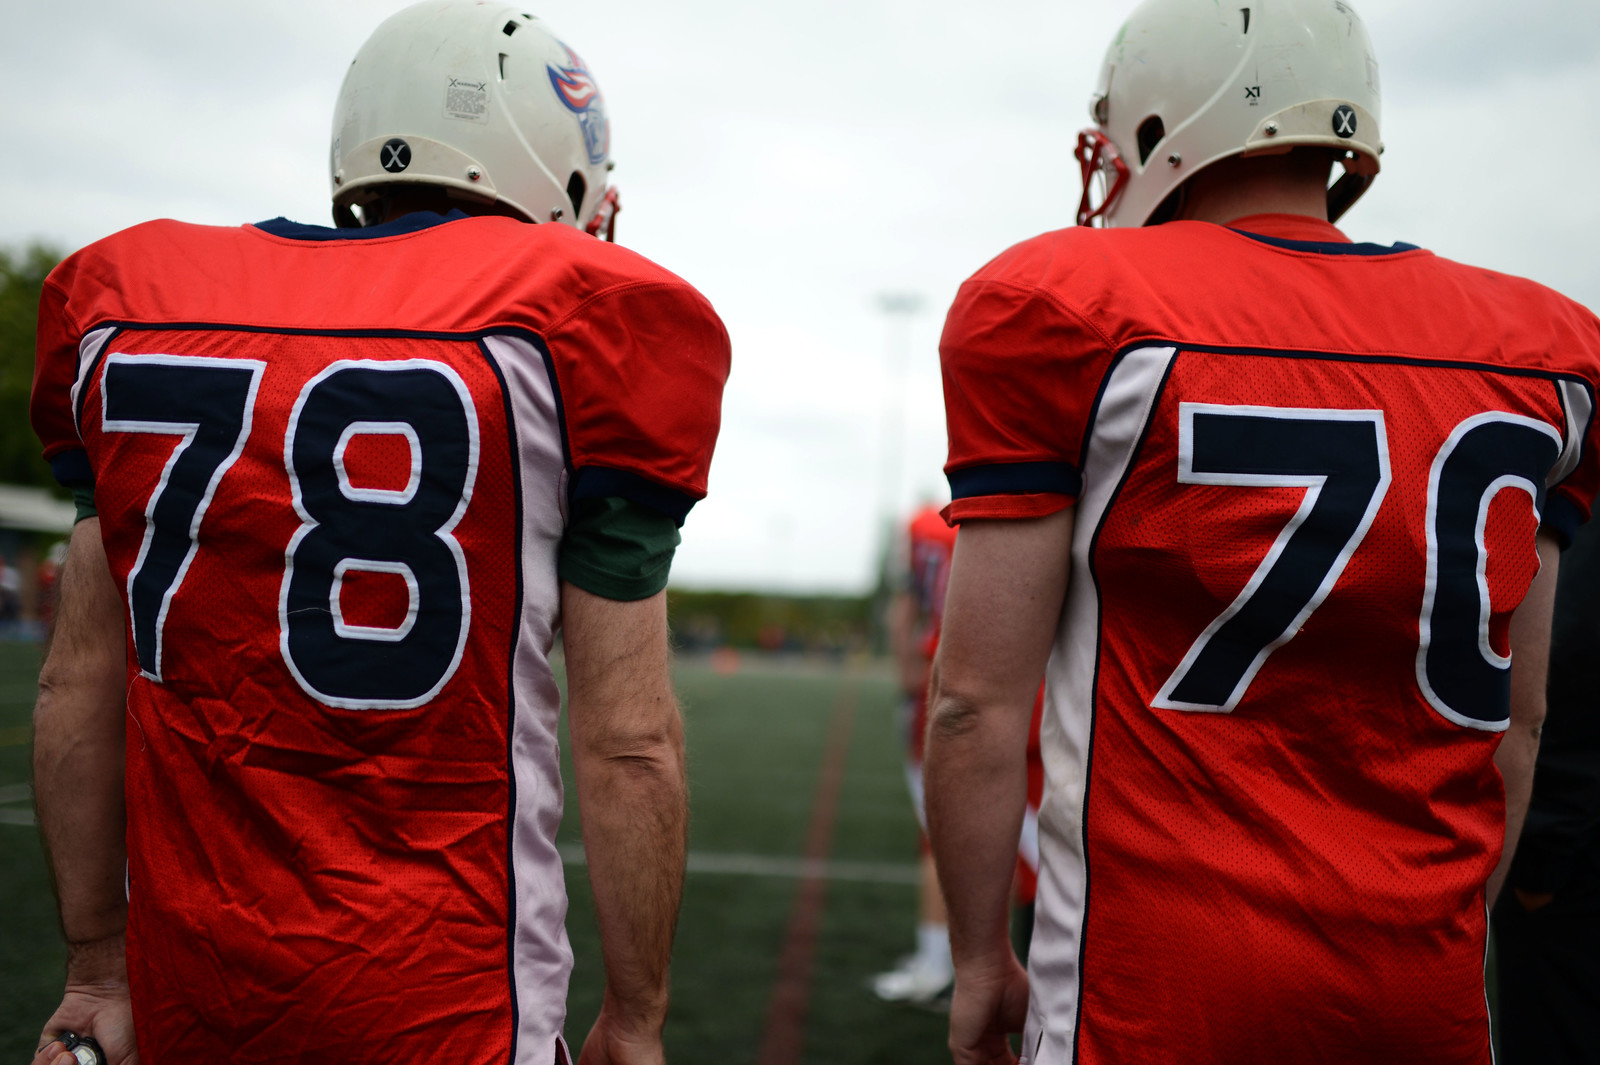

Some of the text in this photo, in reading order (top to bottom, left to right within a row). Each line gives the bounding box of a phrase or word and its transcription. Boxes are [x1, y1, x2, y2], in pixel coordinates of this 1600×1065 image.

[385, 144, 406, 168] X
[1337, 110, 1354, 133] X
[101, 352, 480, 710] 78
[1150, 401, 1562, 732] 70
